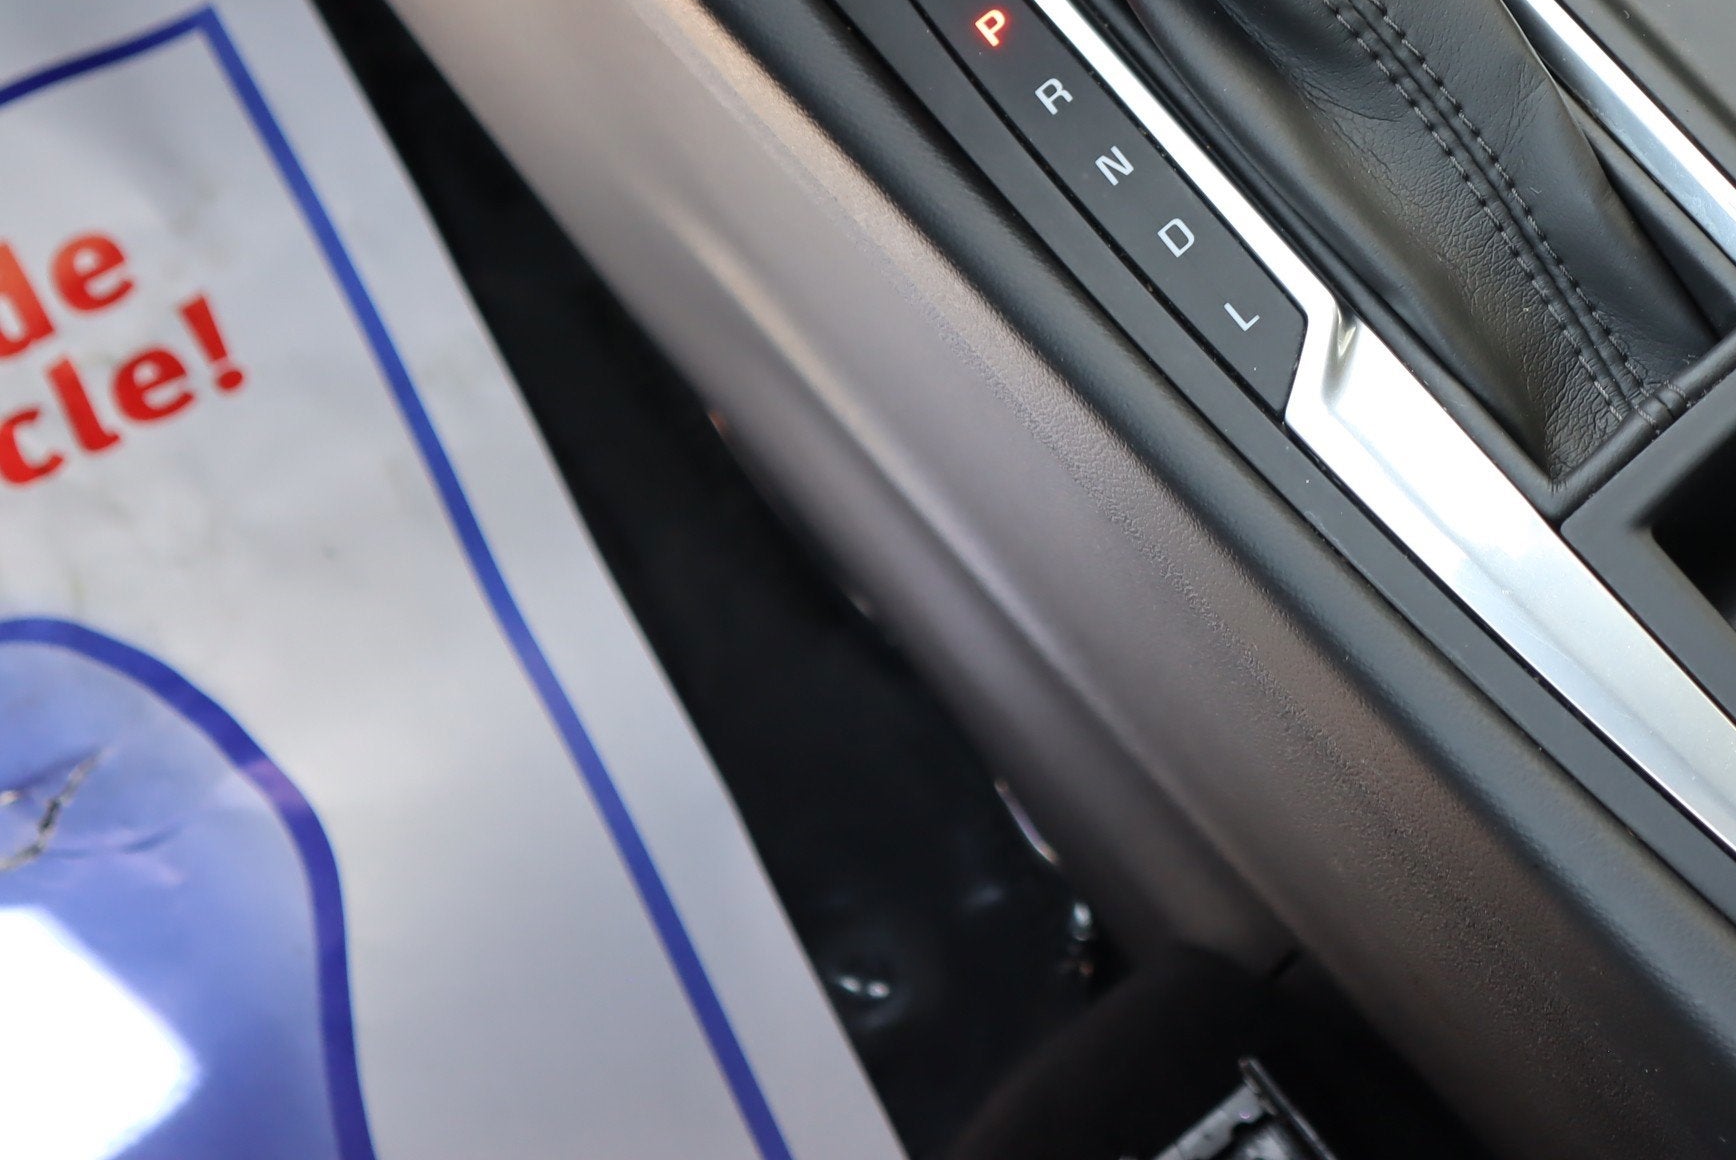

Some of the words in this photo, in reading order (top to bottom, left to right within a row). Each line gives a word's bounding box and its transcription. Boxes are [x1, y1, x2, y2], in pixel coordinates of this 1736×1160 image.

[975, 8, 1007, 47] P
[1035, 77, 1073, 116] R
[1095, 145, 1134, 186] N
[1157, 217, 1195, 258] D
[1224, 301, 1260, 332] L
